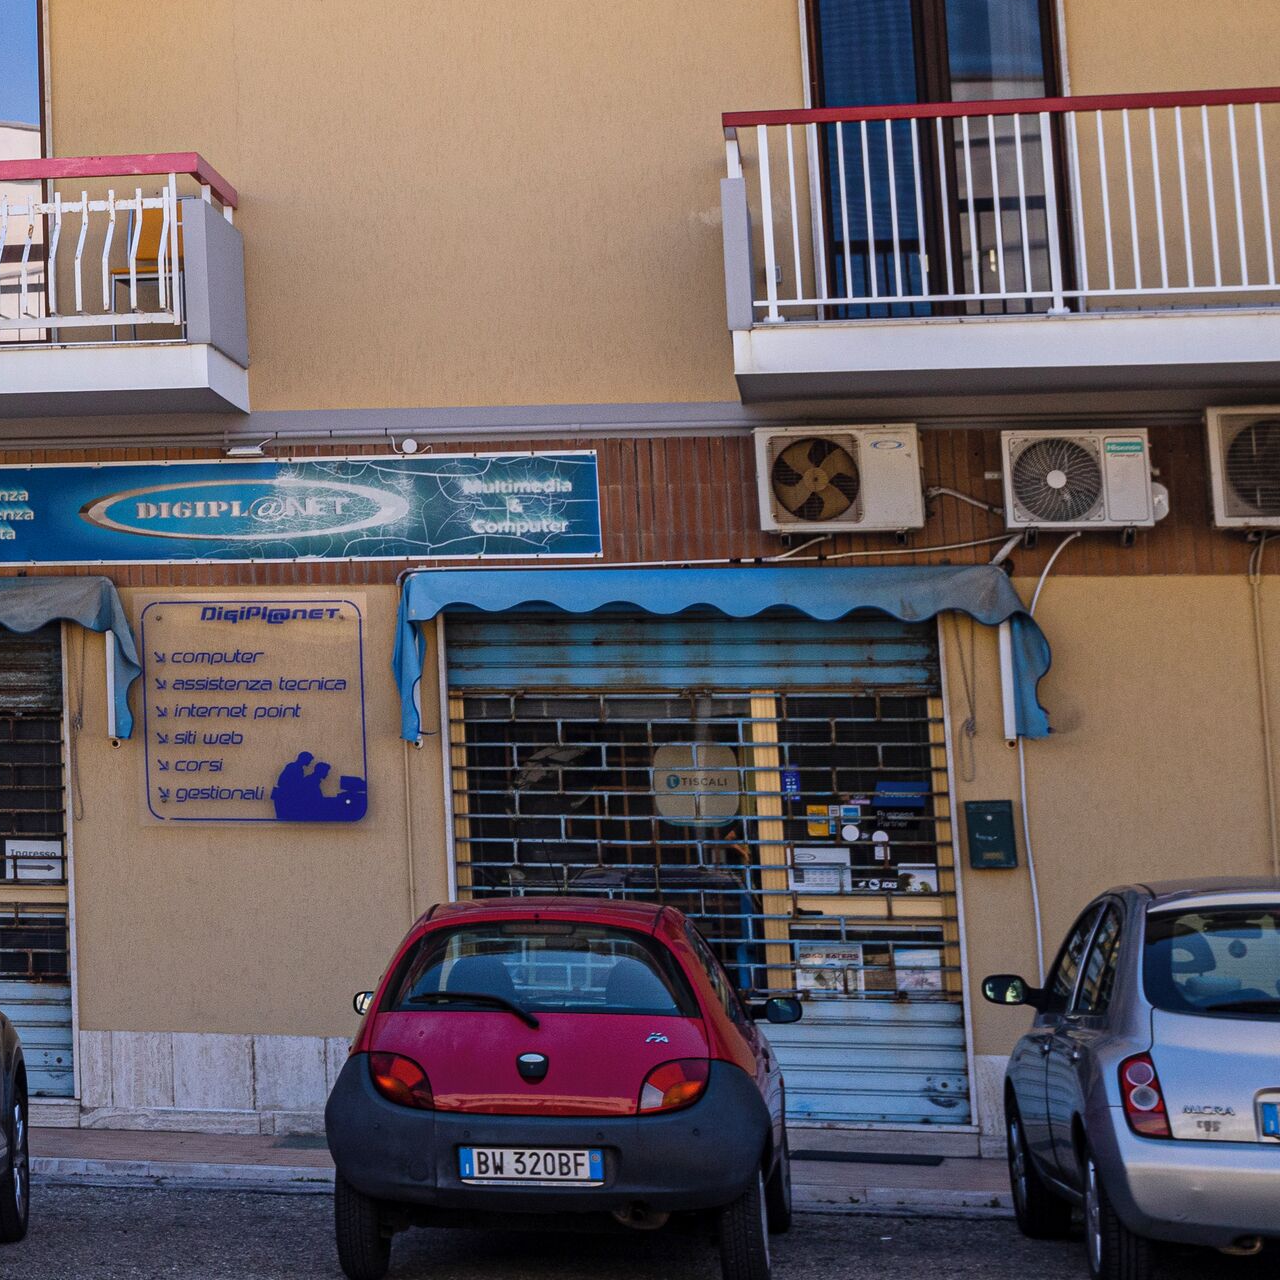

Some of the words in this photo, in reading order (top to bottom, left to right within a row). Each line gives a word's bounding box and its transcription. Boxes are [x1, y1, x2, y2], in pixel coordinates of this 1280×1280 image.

[462, 478, 573, 494] Multimedia
[470, 519, 570, 537] Computer
[171, 649, 264, 665] computer
[172, 677, 272, 691] assistenza
[278, 677, 347, 691] tecnica
[174, 704, 248, 718] internet
[254, 704, 302, 720] point
[174, 731, 197, 745] siti
[202, 731, 244, 745] web
[174, 759, 223, 771] corsi
[681, 778, 728, 786] TISCALI
[175, 786, 264, 802] gestionali
[10, 849, 56, 857] Ingresso
[1182, 1105, 1236, 1116] MICRA
[476, 1151, 504, 1175] BW
[512, 1151, 585, 1176] 320BF
